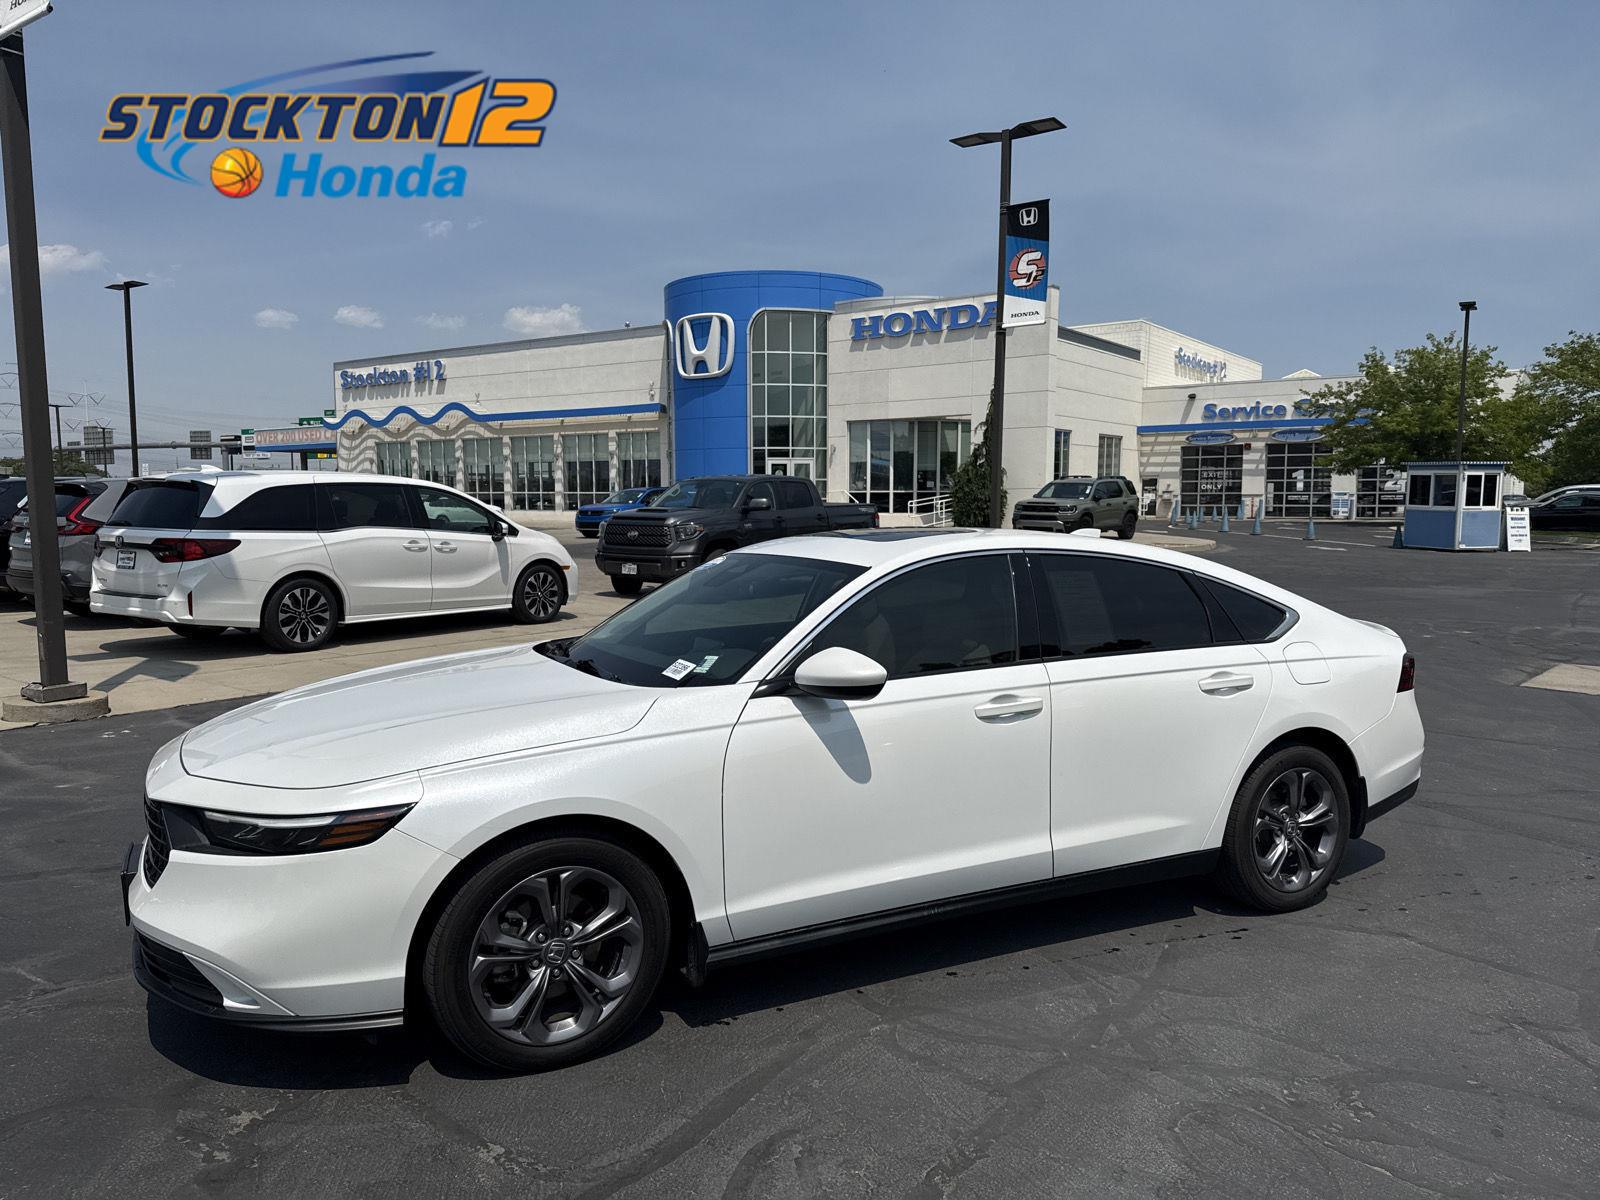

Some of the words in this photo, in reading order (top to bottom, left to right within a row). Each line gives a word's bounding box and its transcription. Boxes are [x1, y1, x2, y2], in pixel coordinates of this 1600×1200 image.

[1010, 310, 1040, 319] HONDA
[340, 366, 411, 389] Stockton
[413, 360, 446, 383] #12
[1203, 399, 1287, 420] Service
[256, 432, 279, 444] OVER
[280, 430, 297, 443] 200
[298, 430, 322, 442] USED
[1292, 469, 1305, 492] 1
